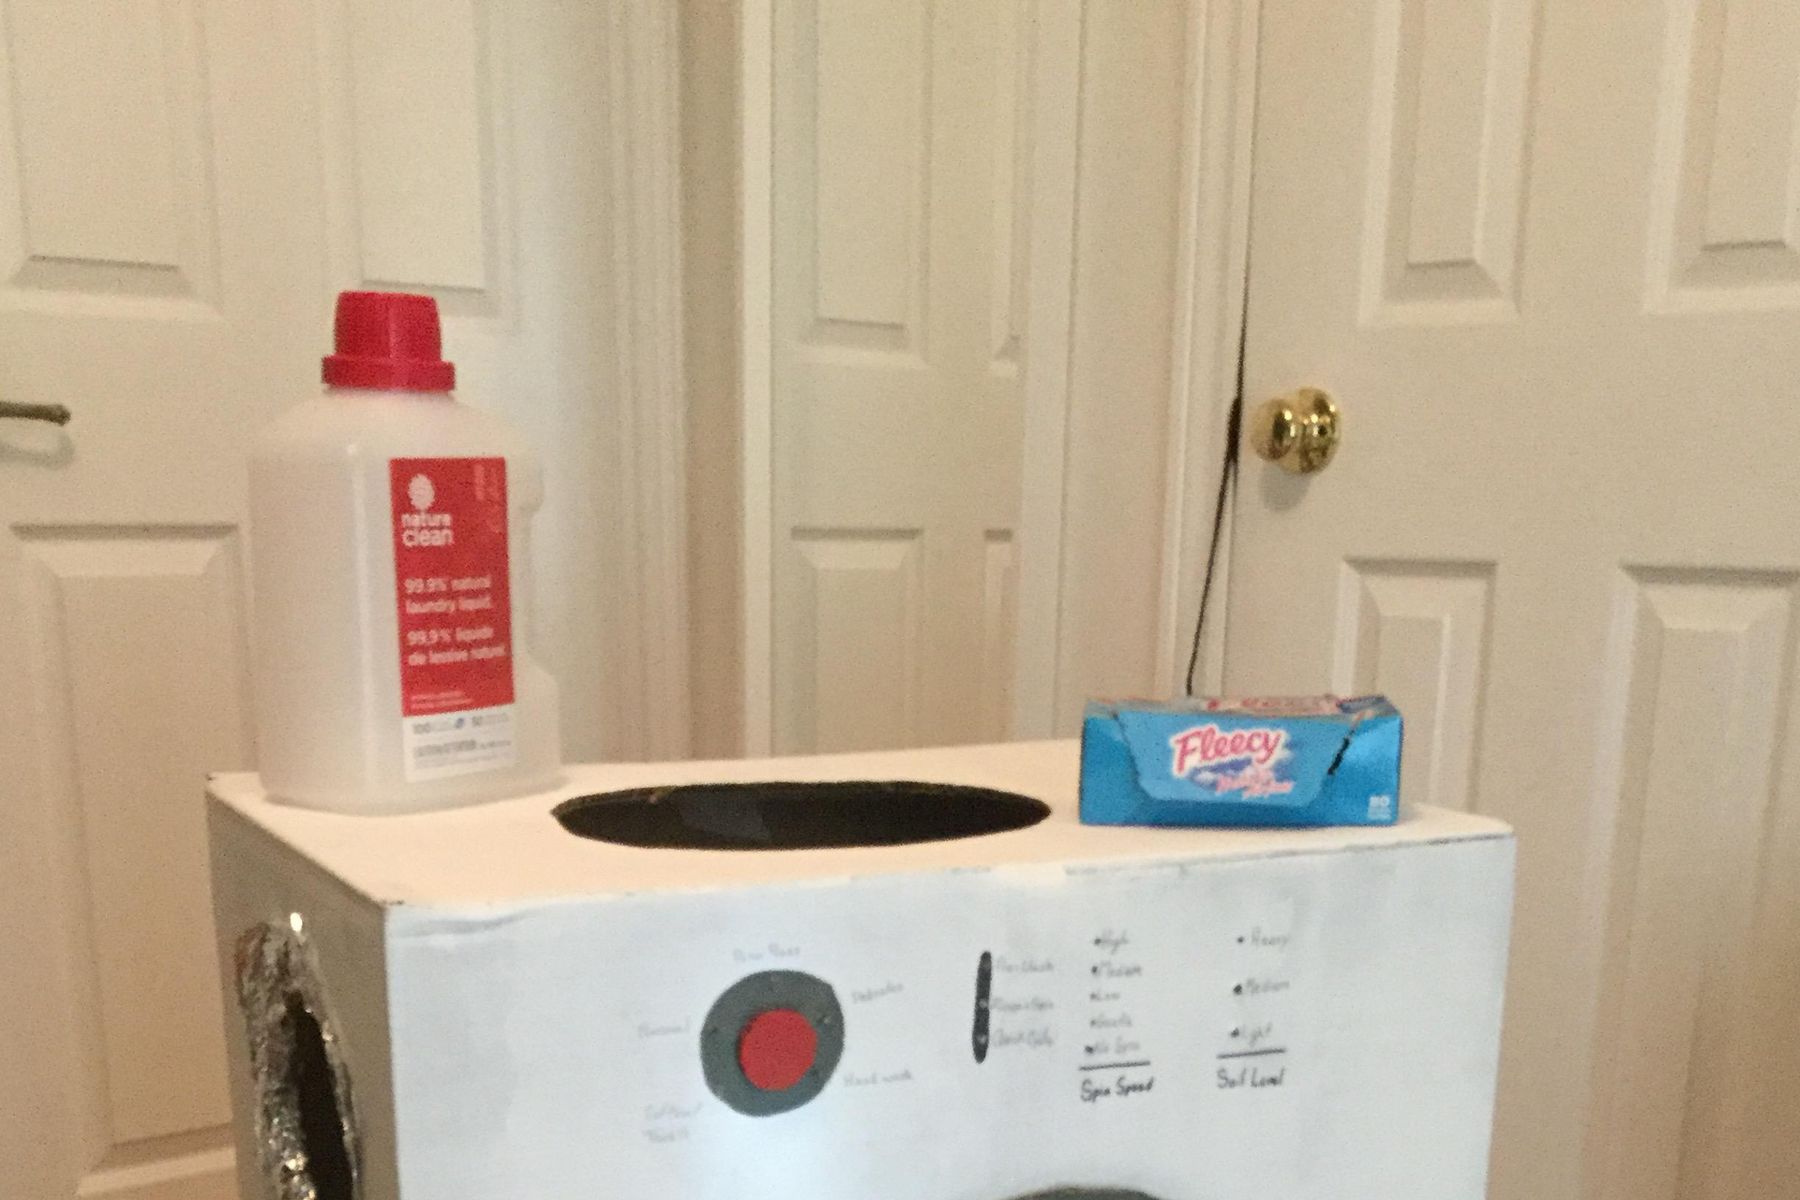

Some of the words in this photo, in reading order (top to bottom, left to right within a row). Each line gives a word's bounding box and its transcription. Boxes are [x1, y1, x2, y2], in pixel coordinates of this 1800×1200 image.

[402, 528, 454, 547] clean
[404, 577, 449, 594] 99.9%
[1173, 725, 1283, 775] Fleecy
[1080, 1077, 1111, 1103] Spin
[1115, 1074, 1155, 1097] Speed
[1216, 1066, 1247, 1090] Soil
[1250, 1066, 1286, 1089] Level
